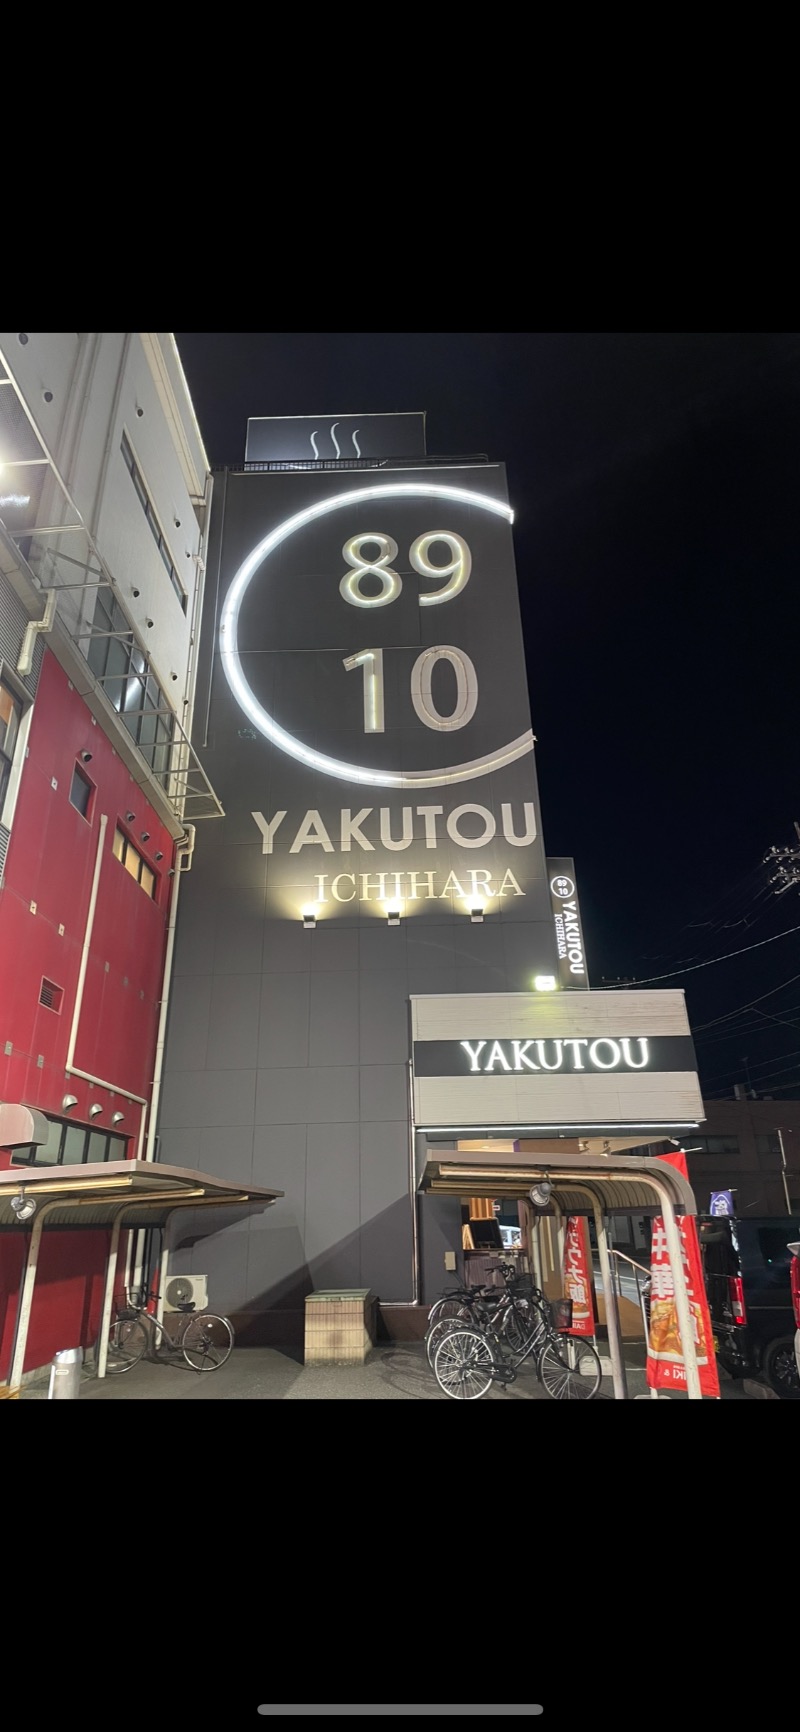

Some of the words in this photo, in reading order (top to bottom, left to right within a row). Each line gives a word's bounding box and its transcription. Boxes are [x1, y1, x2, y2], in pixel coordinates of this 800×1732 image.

[339, 529, 473, 608] 89
[342, 644, 479, 733] 10
[251, 802, 538, 855] YAKUTOU
[314, 868, 526, 903] ICHIHARA
[557, 879, 568, 887] 89
[554, 914, 567, 960] ICHIHARA
[562, 901, 585, 974] YAKUTOU
[460, 1038, 649, 1072] YAKUTOU
